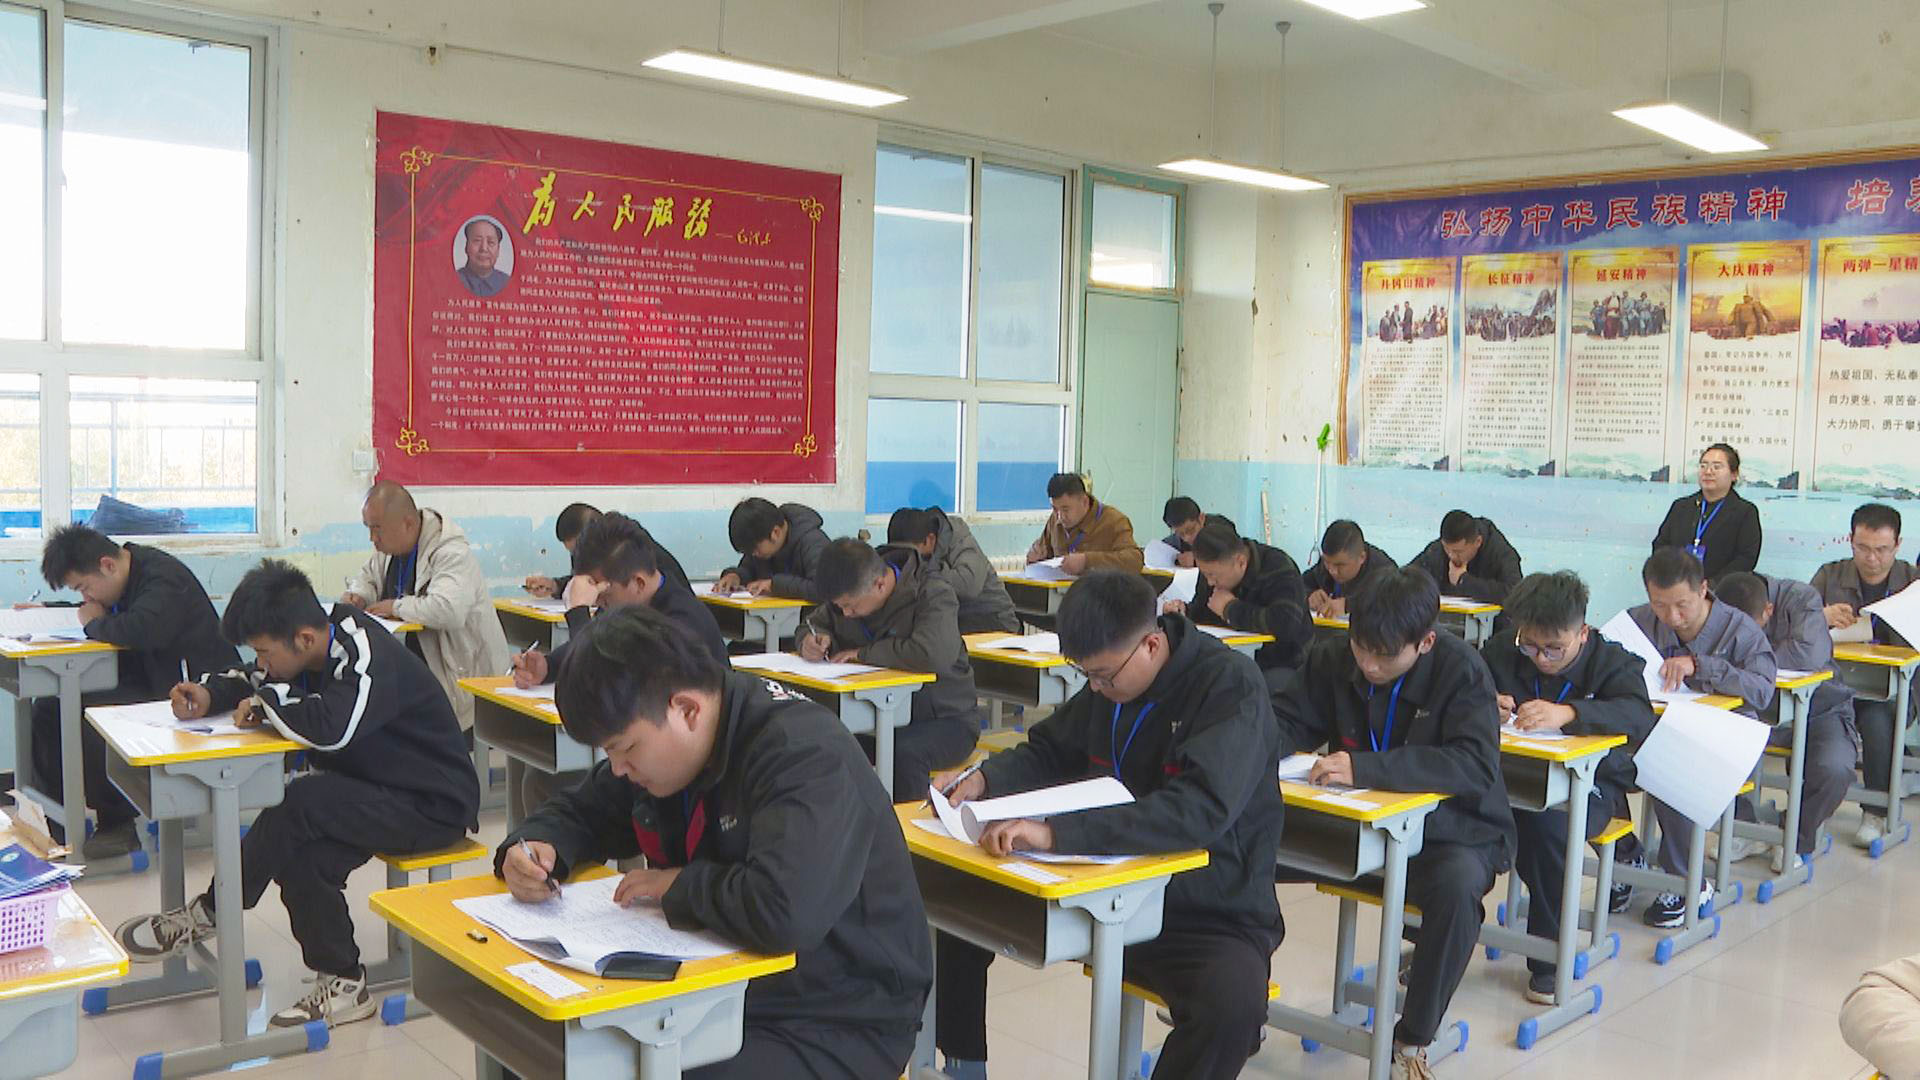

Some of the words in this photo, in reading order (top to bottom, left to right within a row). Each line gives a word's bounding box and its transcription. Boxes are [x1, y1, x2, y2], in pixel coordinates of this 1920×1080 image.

[1441, 185, 1787, 239] 弘扬中华民族精神
[1718, 262, 1775, 278] 大庆精神
[1842, 255, 1919, 273] 两弹一星精
[1488, 271, 1536, 287] 长征精神
[1596, 268, 1648, 281] 延安精神
